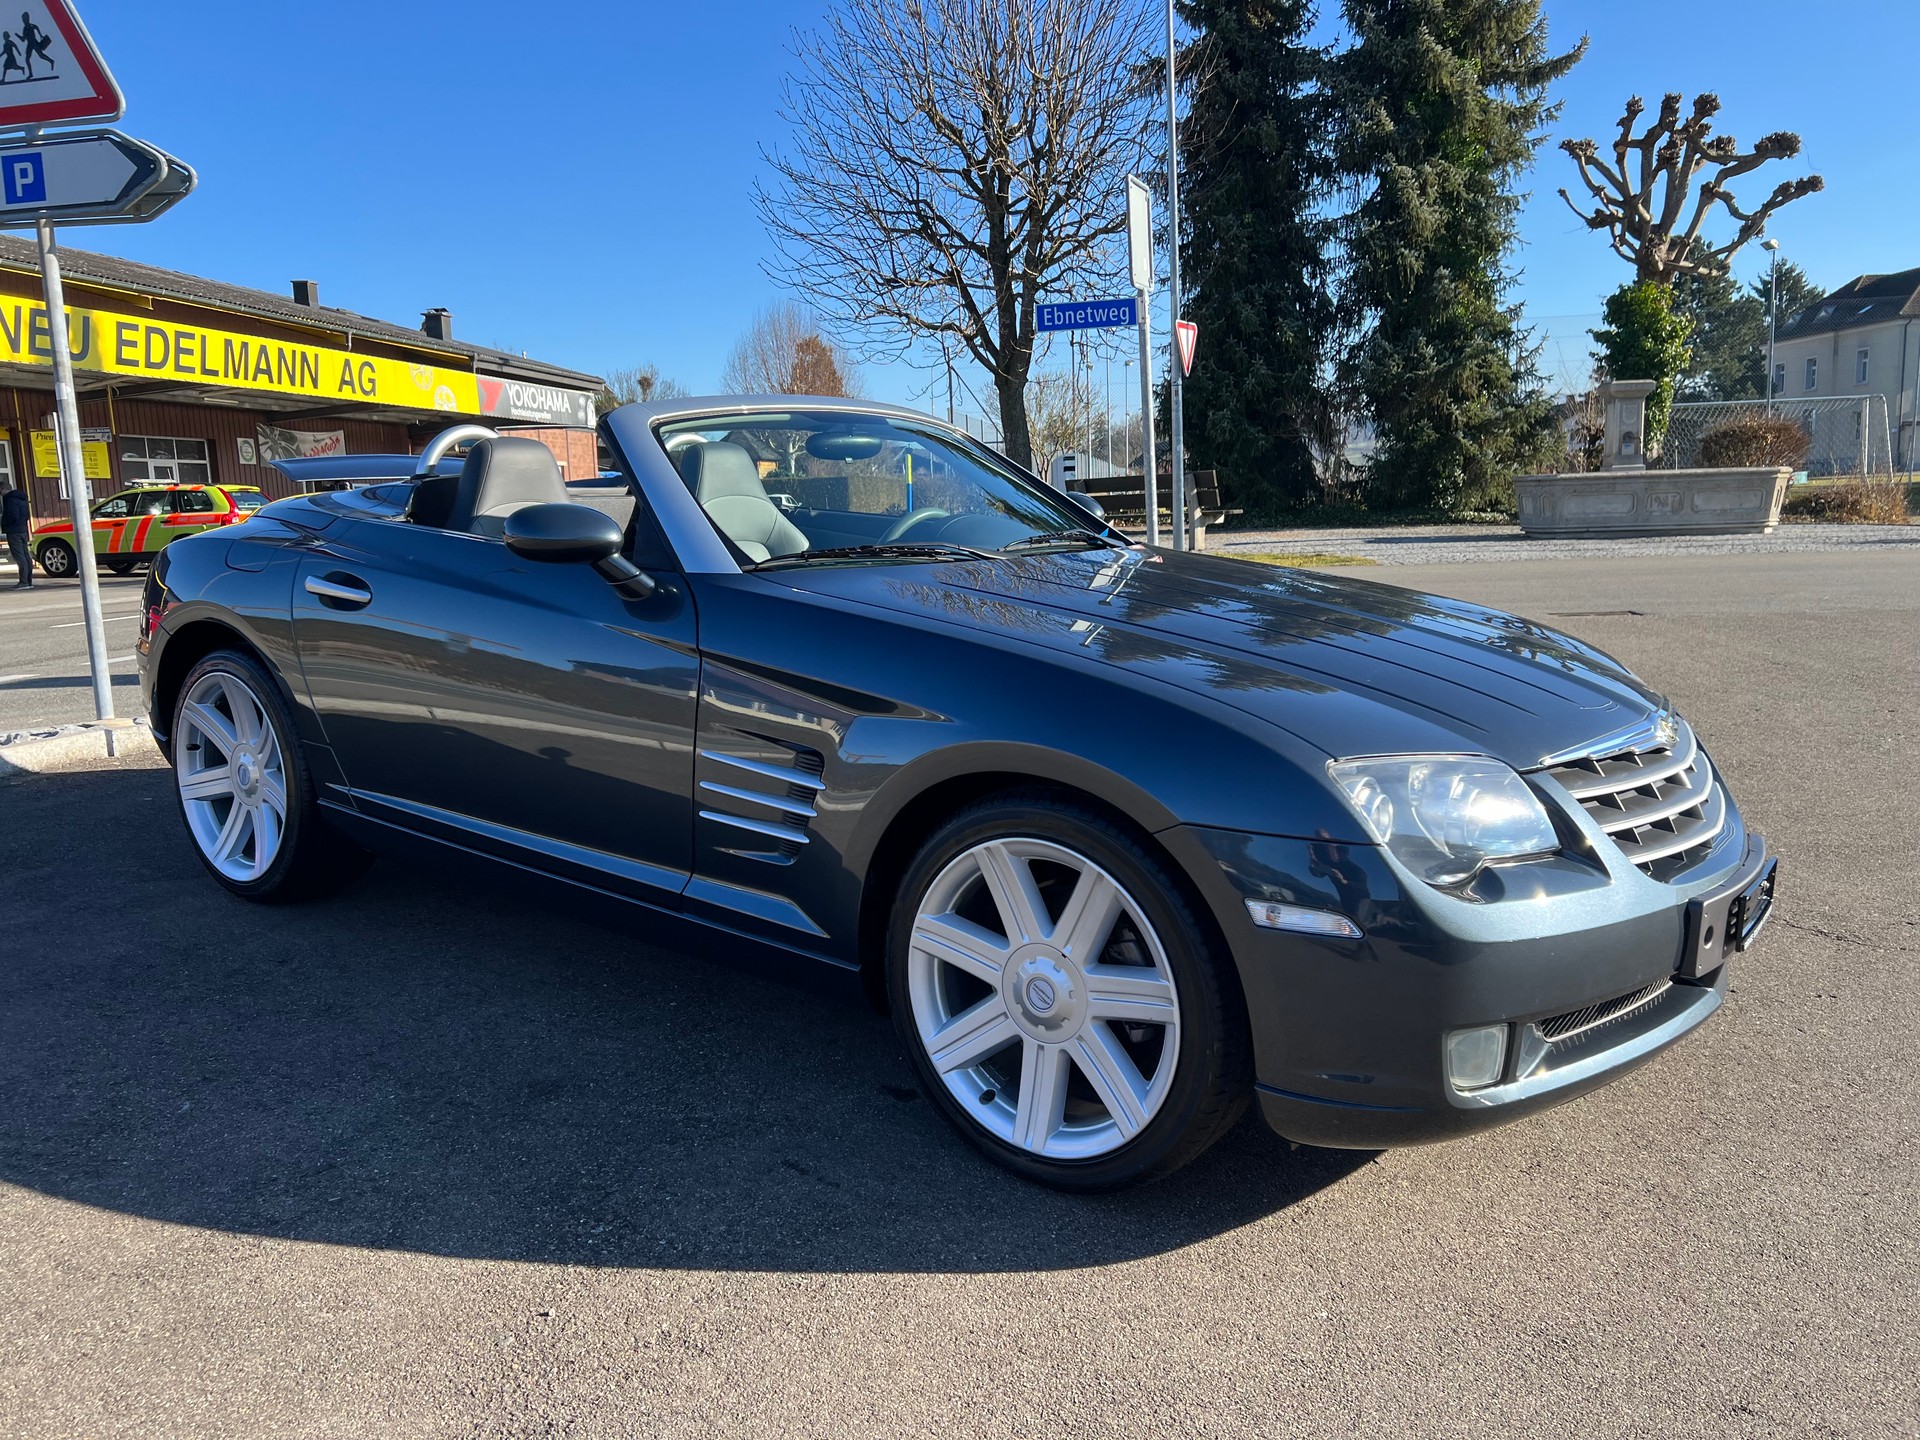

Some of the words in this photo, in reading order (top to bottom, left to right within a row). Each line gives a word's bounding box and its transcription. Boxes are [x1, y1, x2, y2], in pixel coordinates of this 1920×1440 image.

[13, 162, 34, 197] P
[1043, 306, 1130, 325] Ebnetweg
[115, 321, 319, 389] EDELMANN
[338, 358, 377, 397] AG
[505, 383, 572, 413] YOKOHAMA
